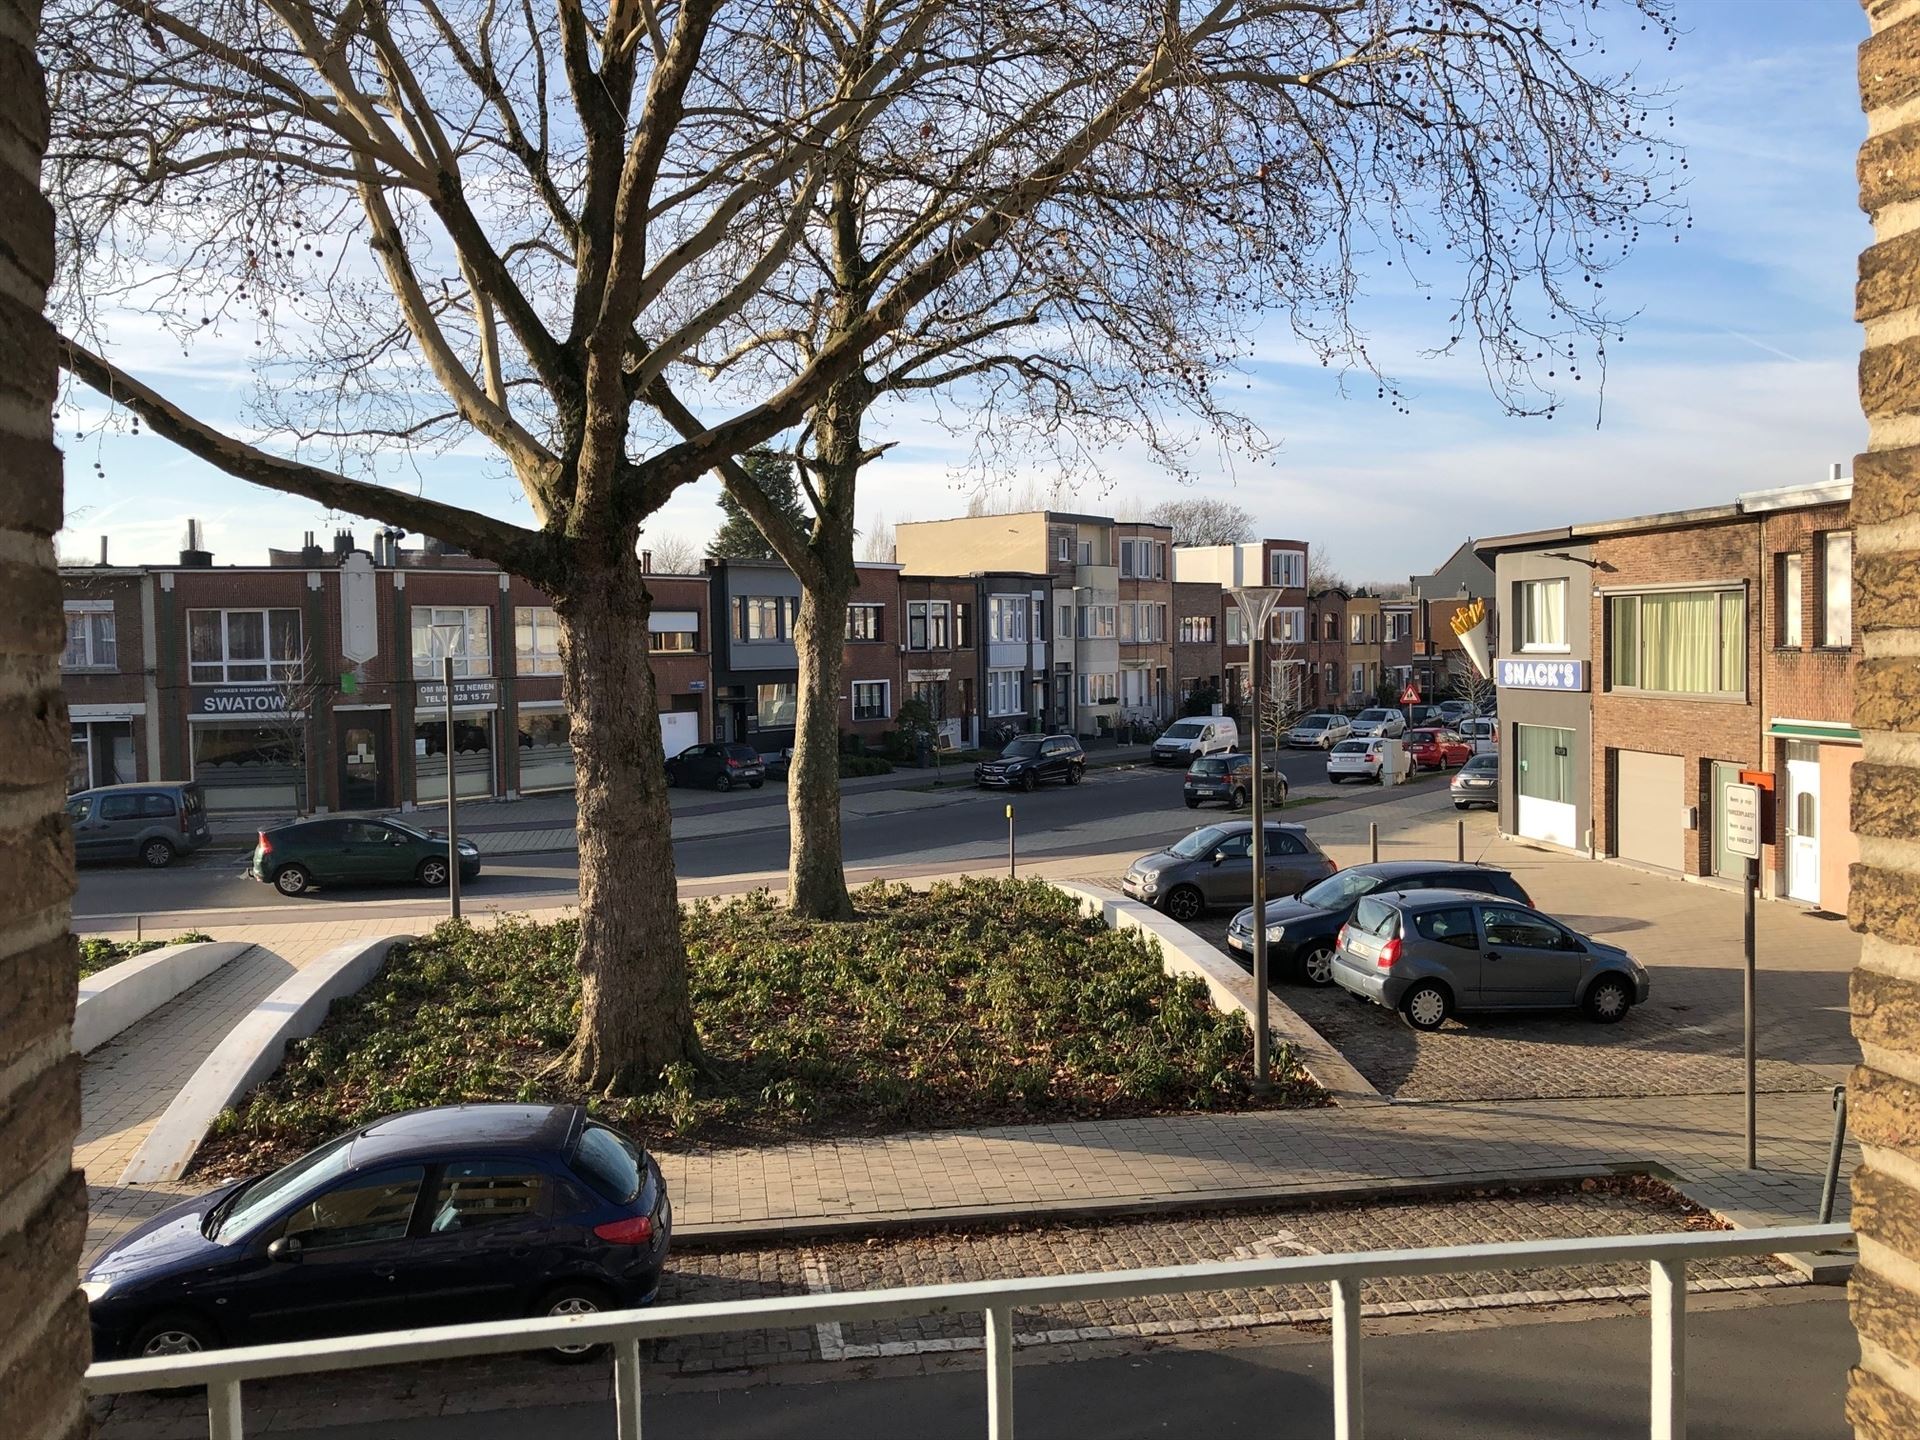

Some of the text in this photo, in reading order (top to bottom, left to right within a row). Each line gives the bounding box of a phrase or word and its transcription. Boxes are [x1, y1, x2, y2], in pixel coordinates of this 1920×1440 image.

[1504, 662, 1574, 687] SNACK'S
[454, 684, 465, 692] TE
[466, 683, 494, 691] NEMEN
[204, 695, 285, 711] SWATOW
[424, 695, 440, 703] TEL
[481, 692, 491, 700] 77
